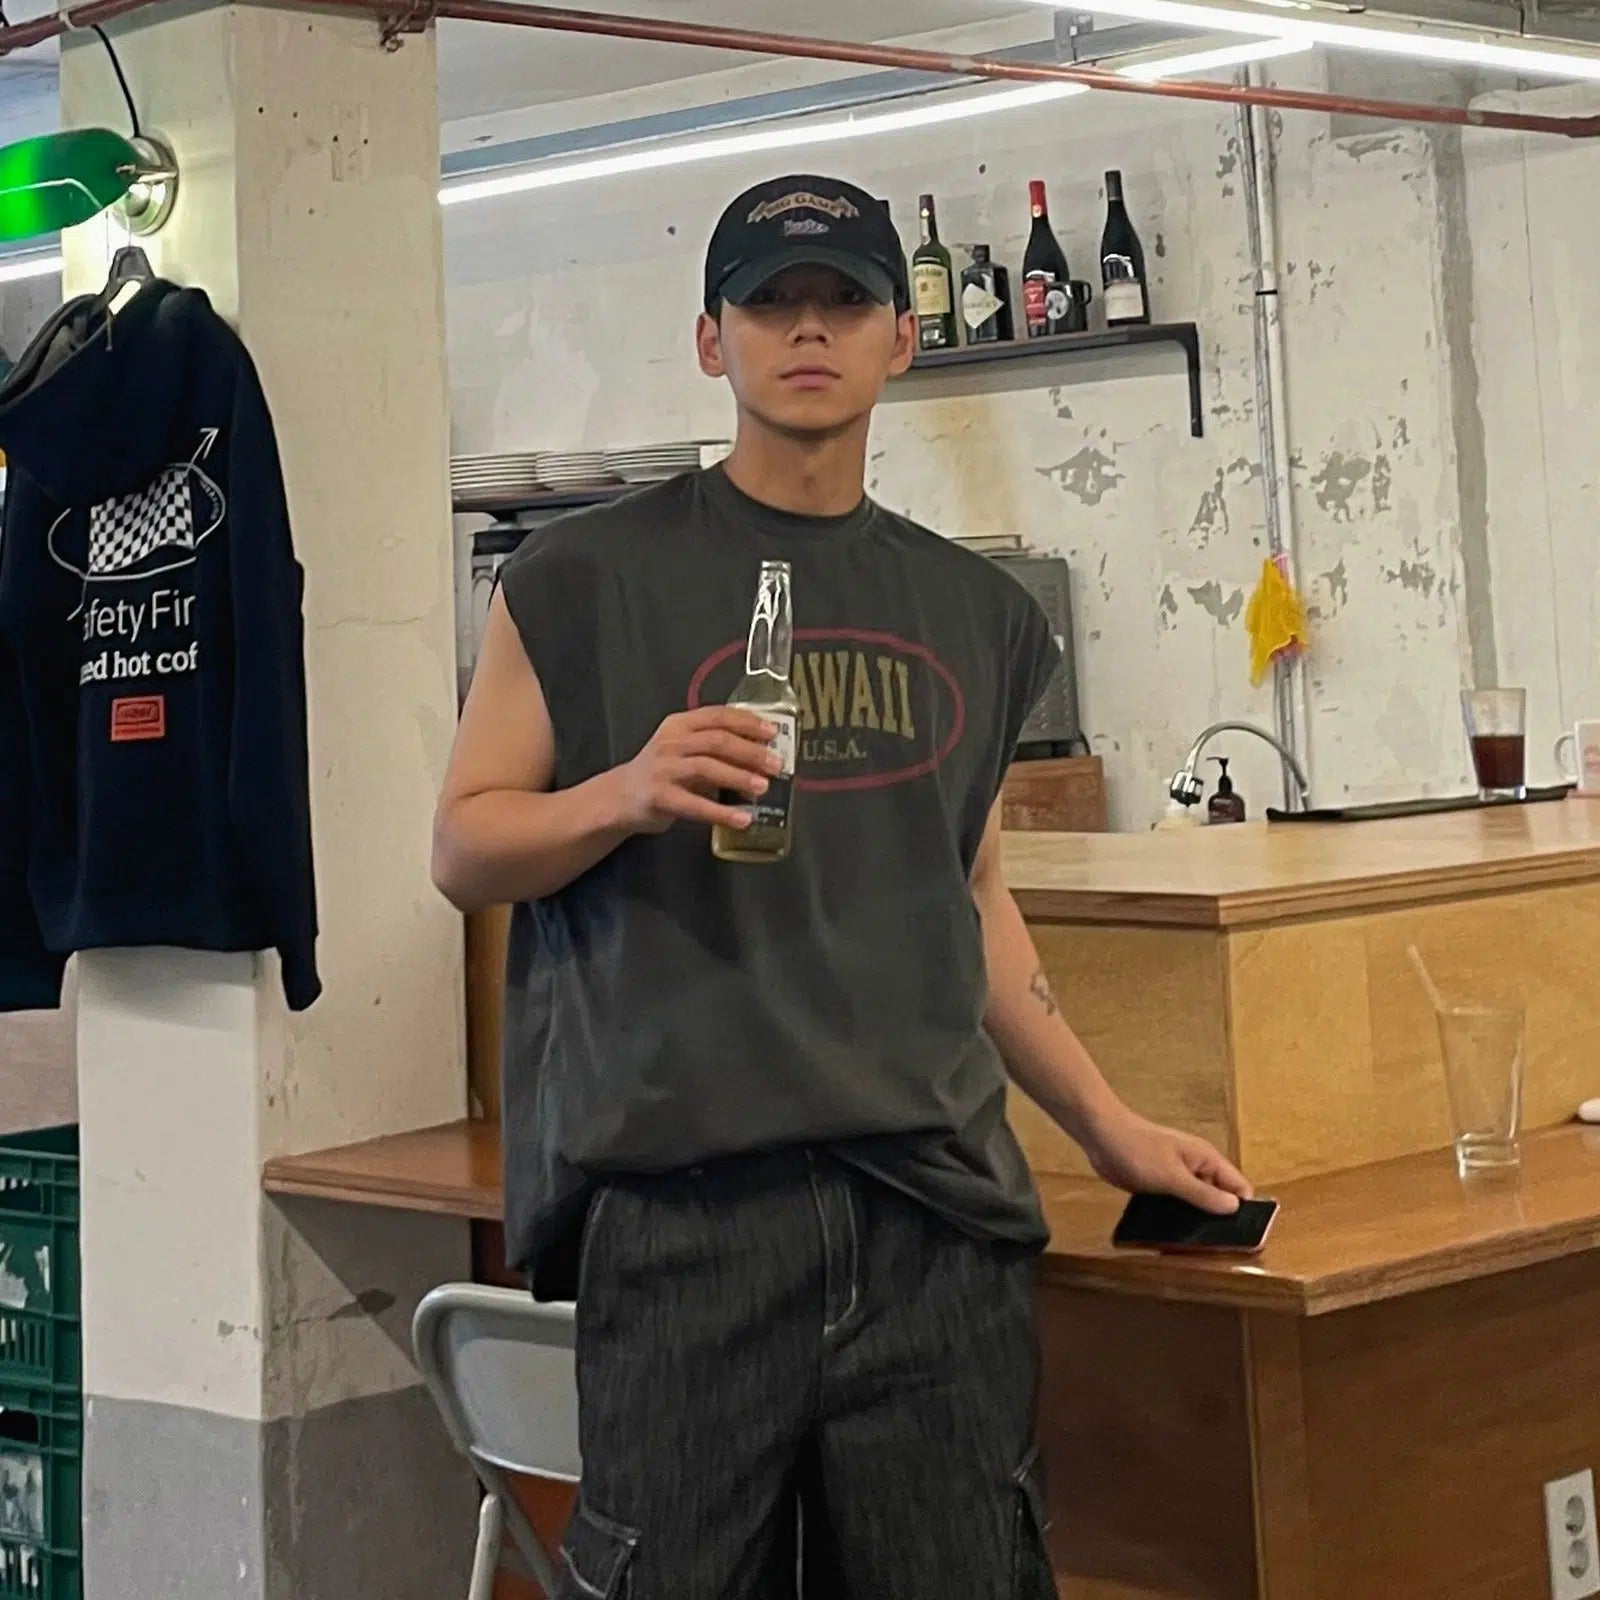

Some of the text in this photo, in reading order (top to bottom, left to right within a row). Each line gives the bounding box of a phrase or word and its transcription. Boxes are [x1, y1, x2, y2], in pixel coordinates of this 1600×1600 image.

[152, 589, 197, 629] Fir
[112, 650, 151, 678] hot
[156, 641, 198, 674] cof
[791, 651, 915, 740] AWAII
[802, 733, 868, 761] U.S.A.
